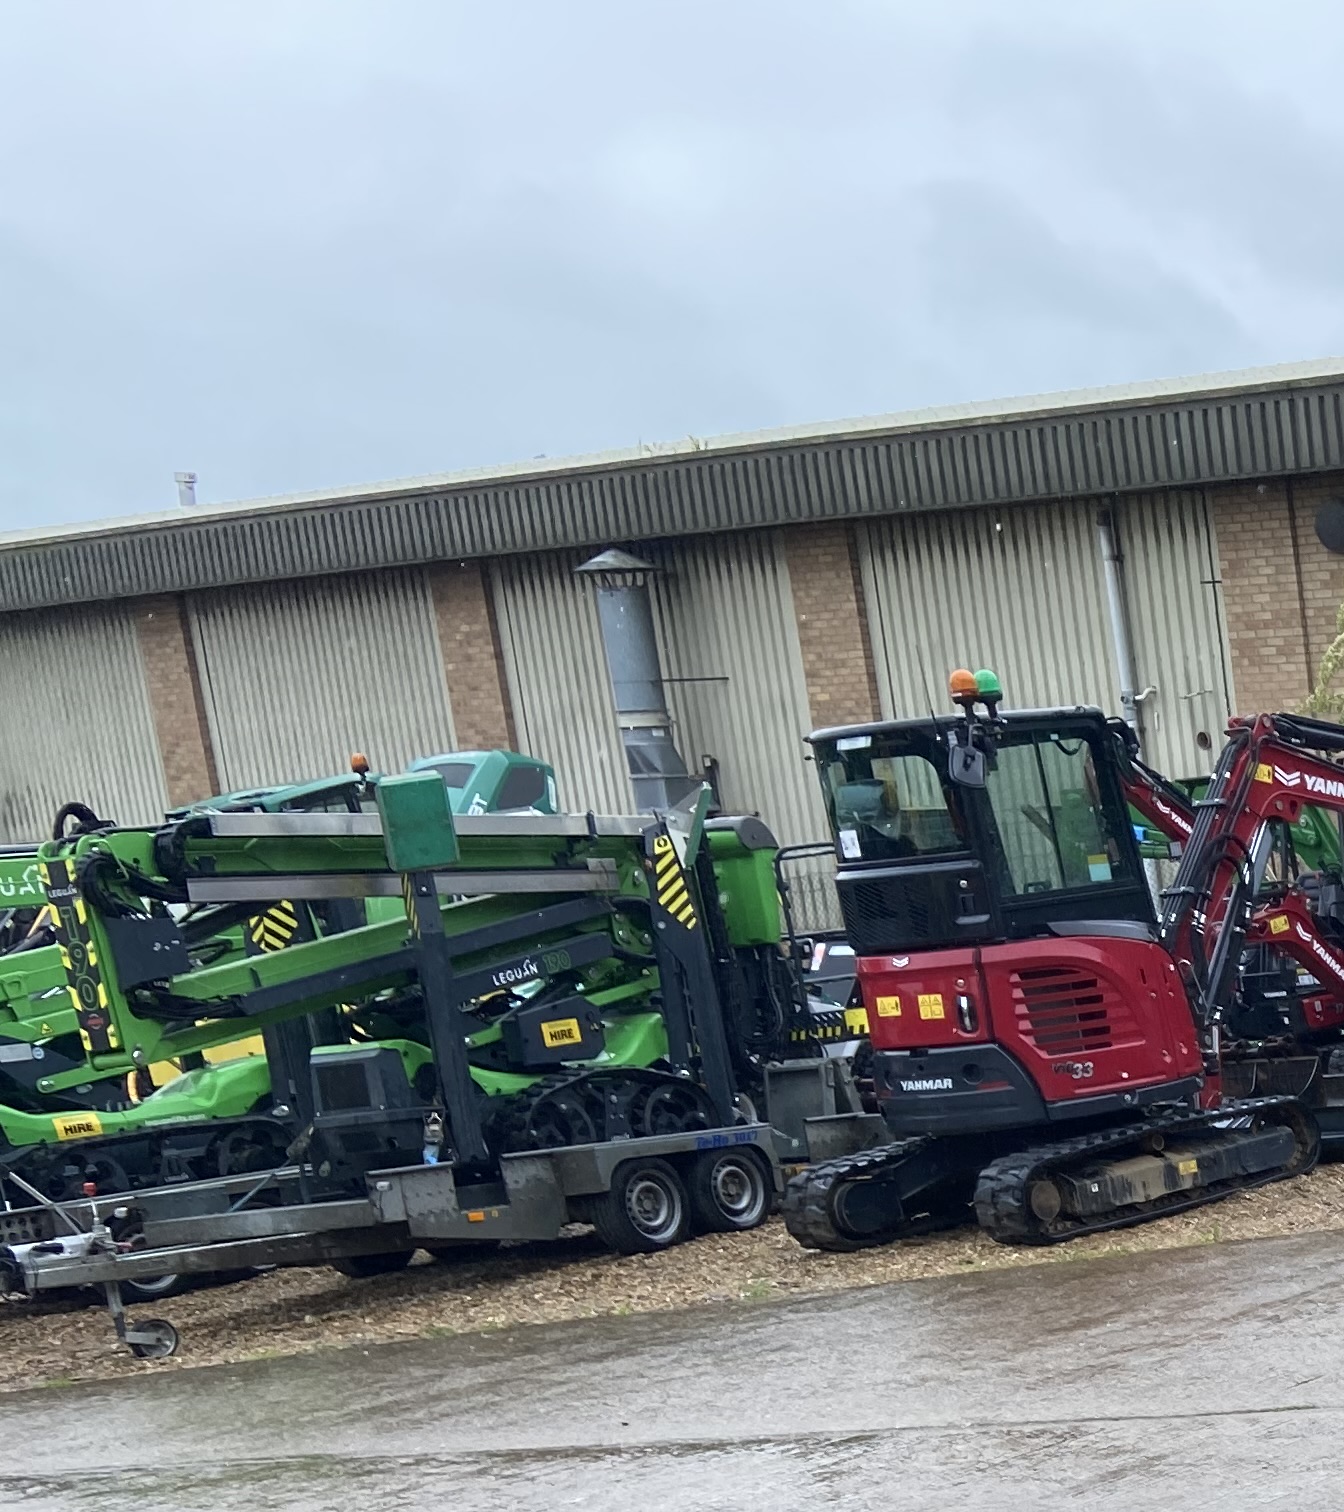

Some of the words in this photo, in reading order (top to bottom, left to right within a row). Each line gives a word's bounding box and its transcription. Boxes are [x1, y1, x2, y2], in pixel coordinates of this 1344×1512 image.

[550, 1028, 574, 1042] HIRE
[900, 1078, 953, 1092] YANMAR
[63, 1122, 94, 1135] HIRE
